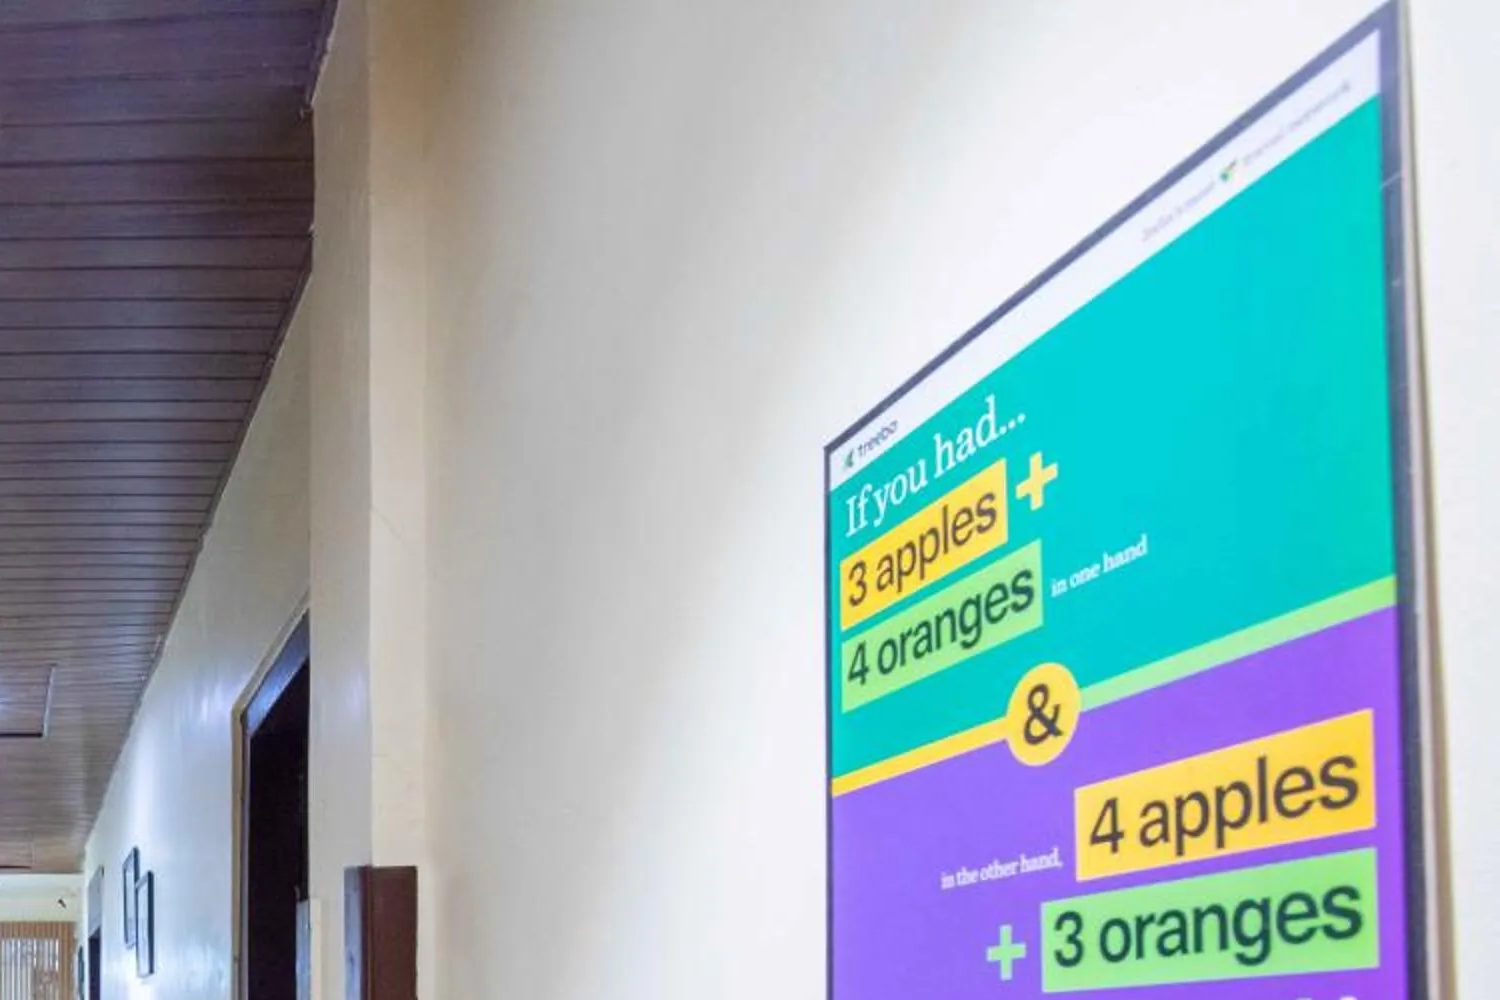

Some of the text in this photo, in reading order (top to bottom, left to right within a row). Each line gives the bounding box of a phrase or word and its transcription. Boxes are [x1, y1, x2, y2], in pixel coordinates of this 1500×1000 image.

[845, 393, 1027, 538] If you had...
[848, 560, 867, 607] 3
[876, 491, 998, 594] apples
[1051, 533, 1148, 597] in one hand
[847, 568, 1036, 686] 4 oranges
[1023, 683, 1065, 744] &
[1089, 753, 1360, 856] 4 apples
[941, 871, 955, 889] in
[956, 866, 979, 886] the
[980, 858, 1020, 881] other
[1053, 910, 1084, 969] 3
[1099, 884, 1364, 967] oranges
